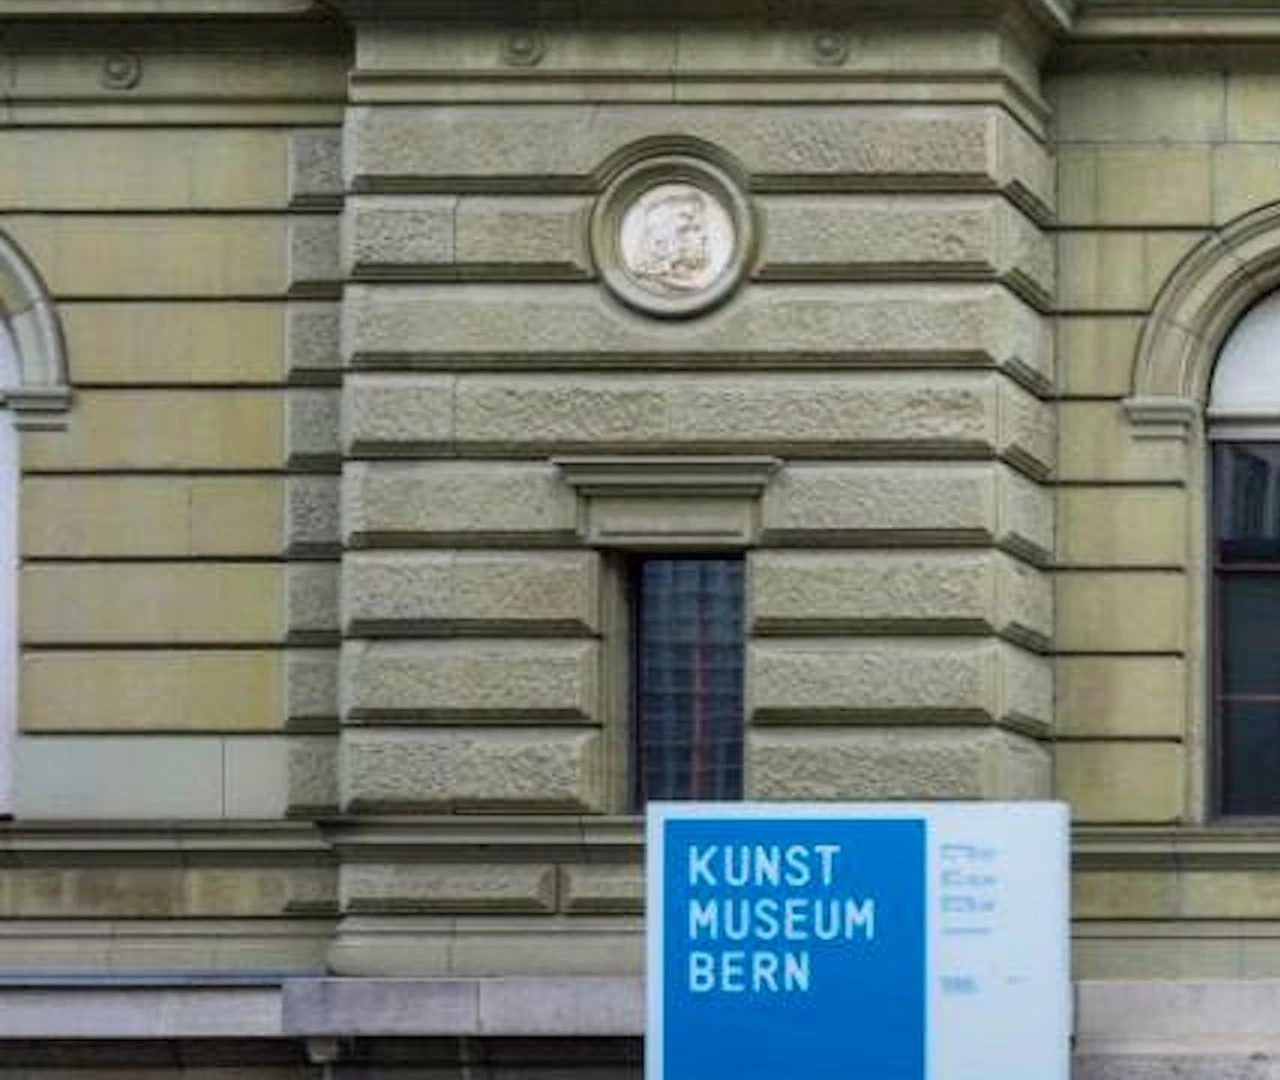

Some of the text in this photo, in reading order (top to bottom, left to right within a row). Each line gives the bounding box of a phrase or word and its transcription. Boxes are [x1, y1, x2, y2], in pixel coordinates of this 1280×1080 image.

[687, 844, 841, 887] KUNST
[687, 898, 876, 941] MUSEUM
[687, 951, 811, 993] BERN
